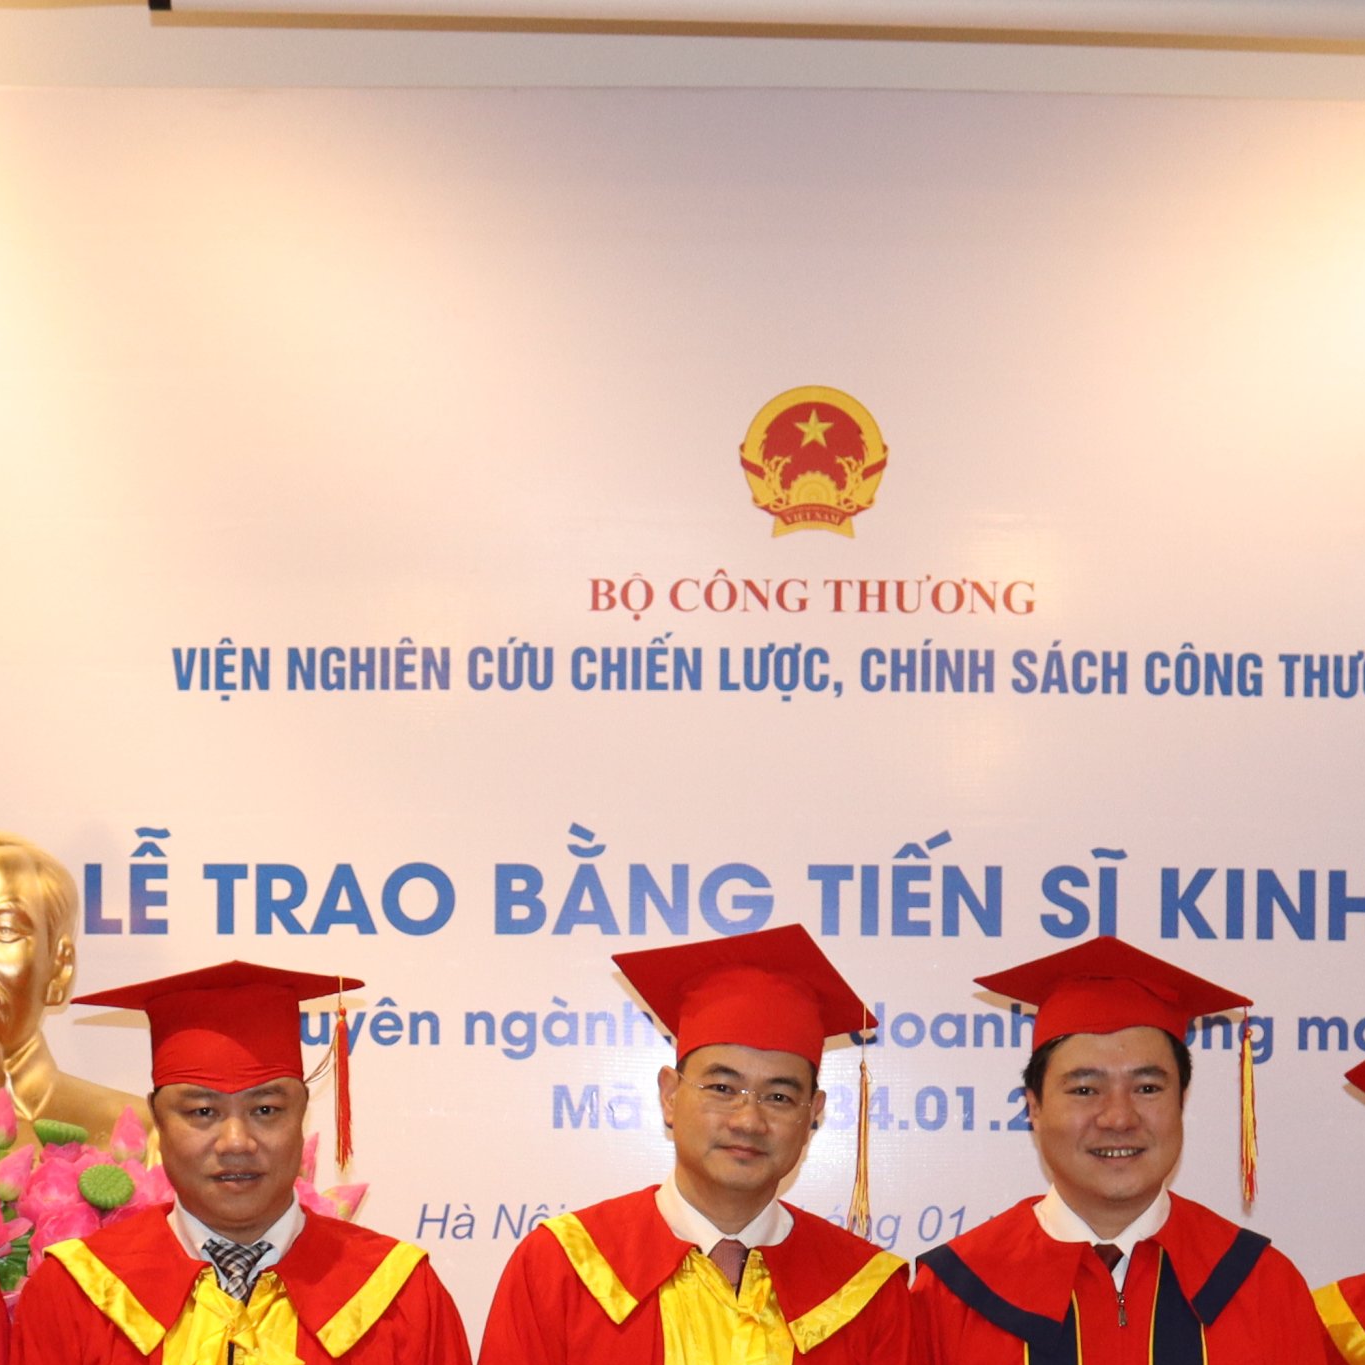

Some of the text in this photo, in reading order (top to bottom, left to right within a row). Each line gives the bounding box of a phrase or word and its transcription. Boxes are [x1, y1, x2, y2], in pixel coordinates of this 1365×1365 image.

[591, 569, 1034, 621] BỘ CÔNG THƯƠNG
[172, 638, 270, 701] VIỆN
[287, 637, 450, 691] NGHIÊN
[468, 637, 553, 691] CỨU
[571, 632, 702, 691] CHIẾN
[720, 643, 842, 702] LƯỢC,
[861, 639, 994, 693] CHÍNH
[1012, 640, 1127, 694] SÁCH
[1145, 643, 1262, 697] CÔNG
[83, 826, 171, 936] LỄ
[203, 861, 456, 937] TRAO
[494, 822, 775, 937] BẰNG
[807, 830, 1003, 938] TIẾN
[1040, 847, 1128, 940] SĨ
[299, 997, 440, 1056] uyên
[416, 1203, 476, 1239] Hà
[918, 1205, 966, 1243] 01
